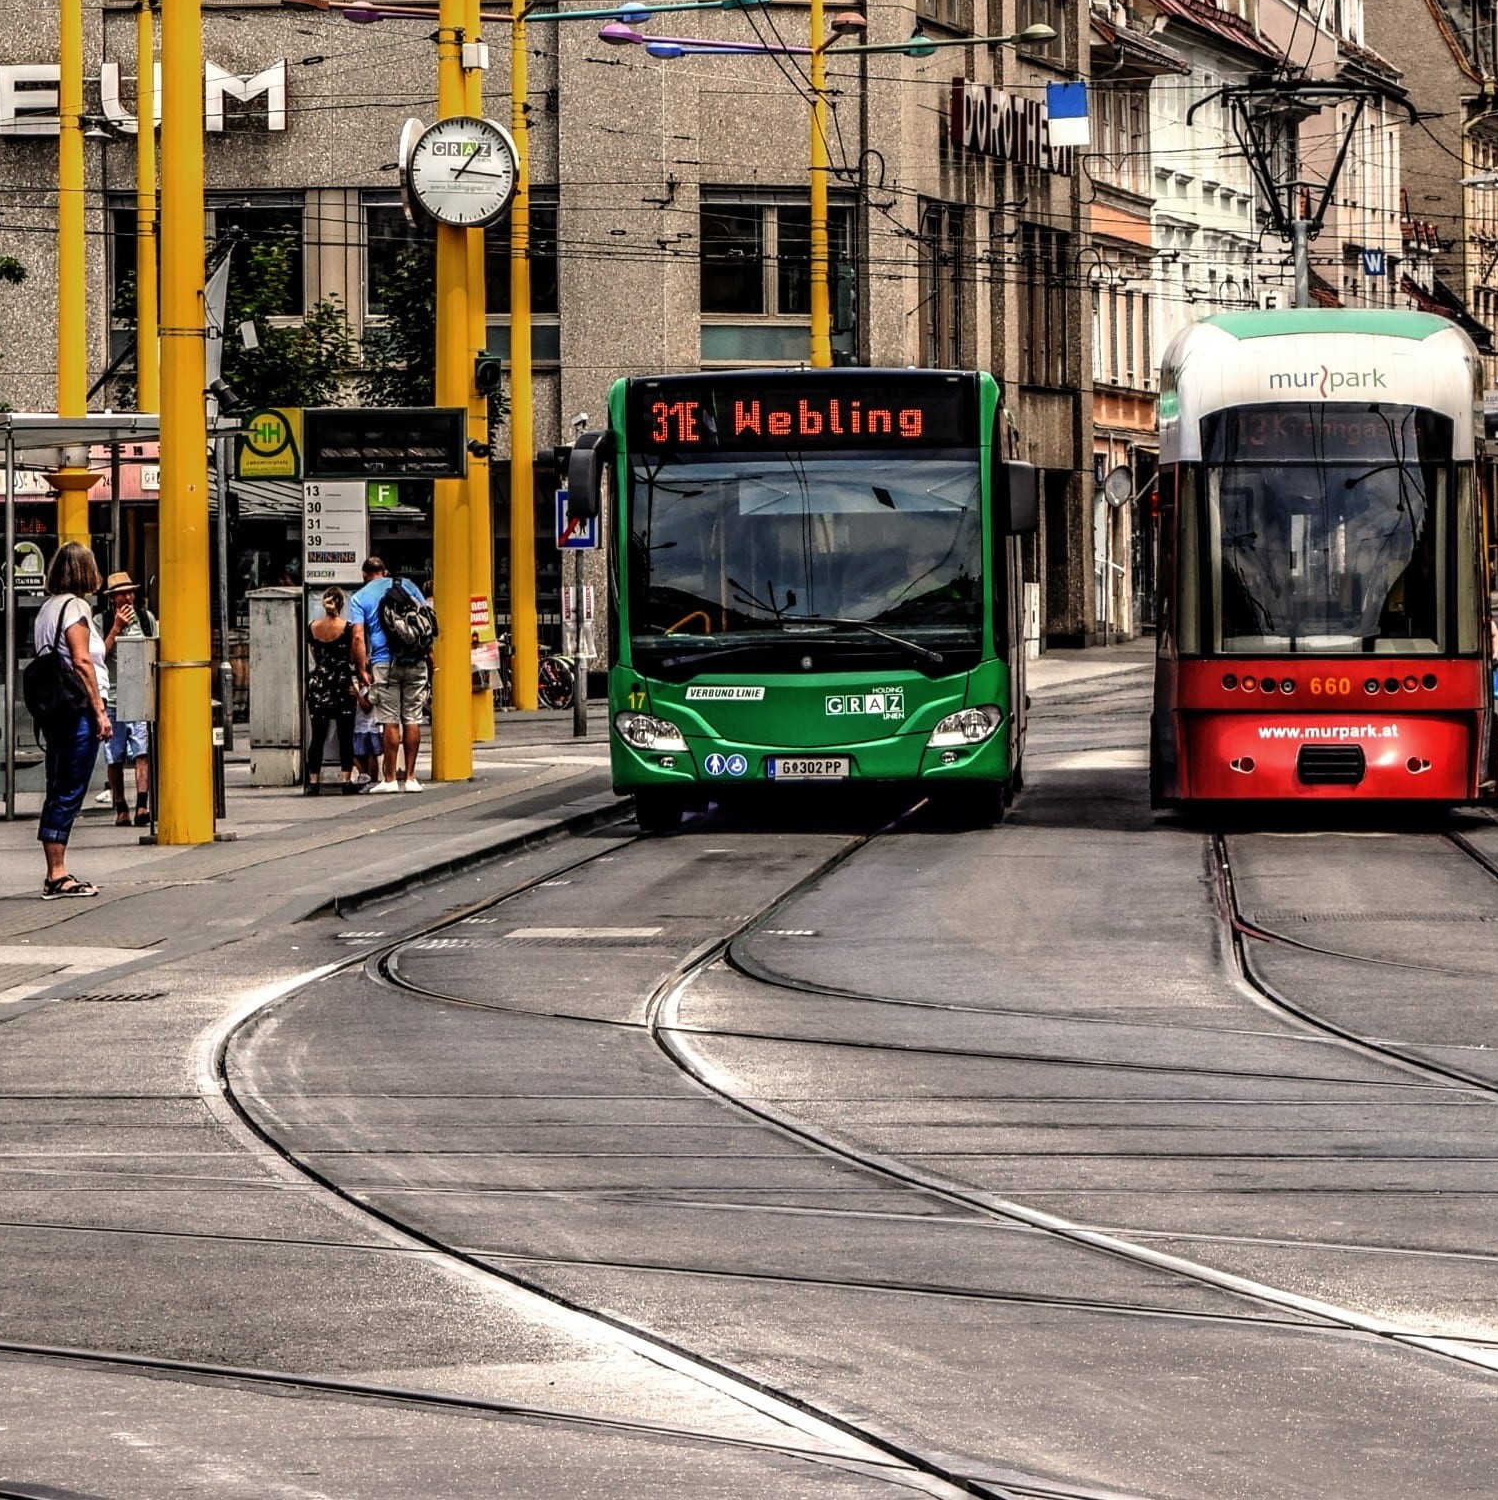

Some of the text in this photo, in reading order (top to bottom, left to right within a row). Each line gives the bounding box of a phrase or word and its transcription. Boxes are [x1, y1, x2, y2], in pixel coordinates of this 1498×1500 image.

[433, 142, 491, 157] GRAZ
[1365, 254, 1382, 272] W
[652, 399, 922, 442] 31E Webling
[306, 486, 319, 497] 13
[378, 485, 390, 502] F
[307, 502, 321, 513] 30
[307, 518, 321, 530] 31
[307, 535, 321, 546] 39
[341, 552, 355, 562] N6
[872, 686, 904, 694] HOLDING
[1310, 677, 1351, 695] 660
[689, 688, 763, 698] VERBUND LINIE
[628, 691, 645, 709] 17
[826, 694, 904, 714] GRAZ
[883, 712, 904, 720] LINIEN
[1258, 724, 1398, 740] www.murpark.at
[825, 761, 842, 774] PP
